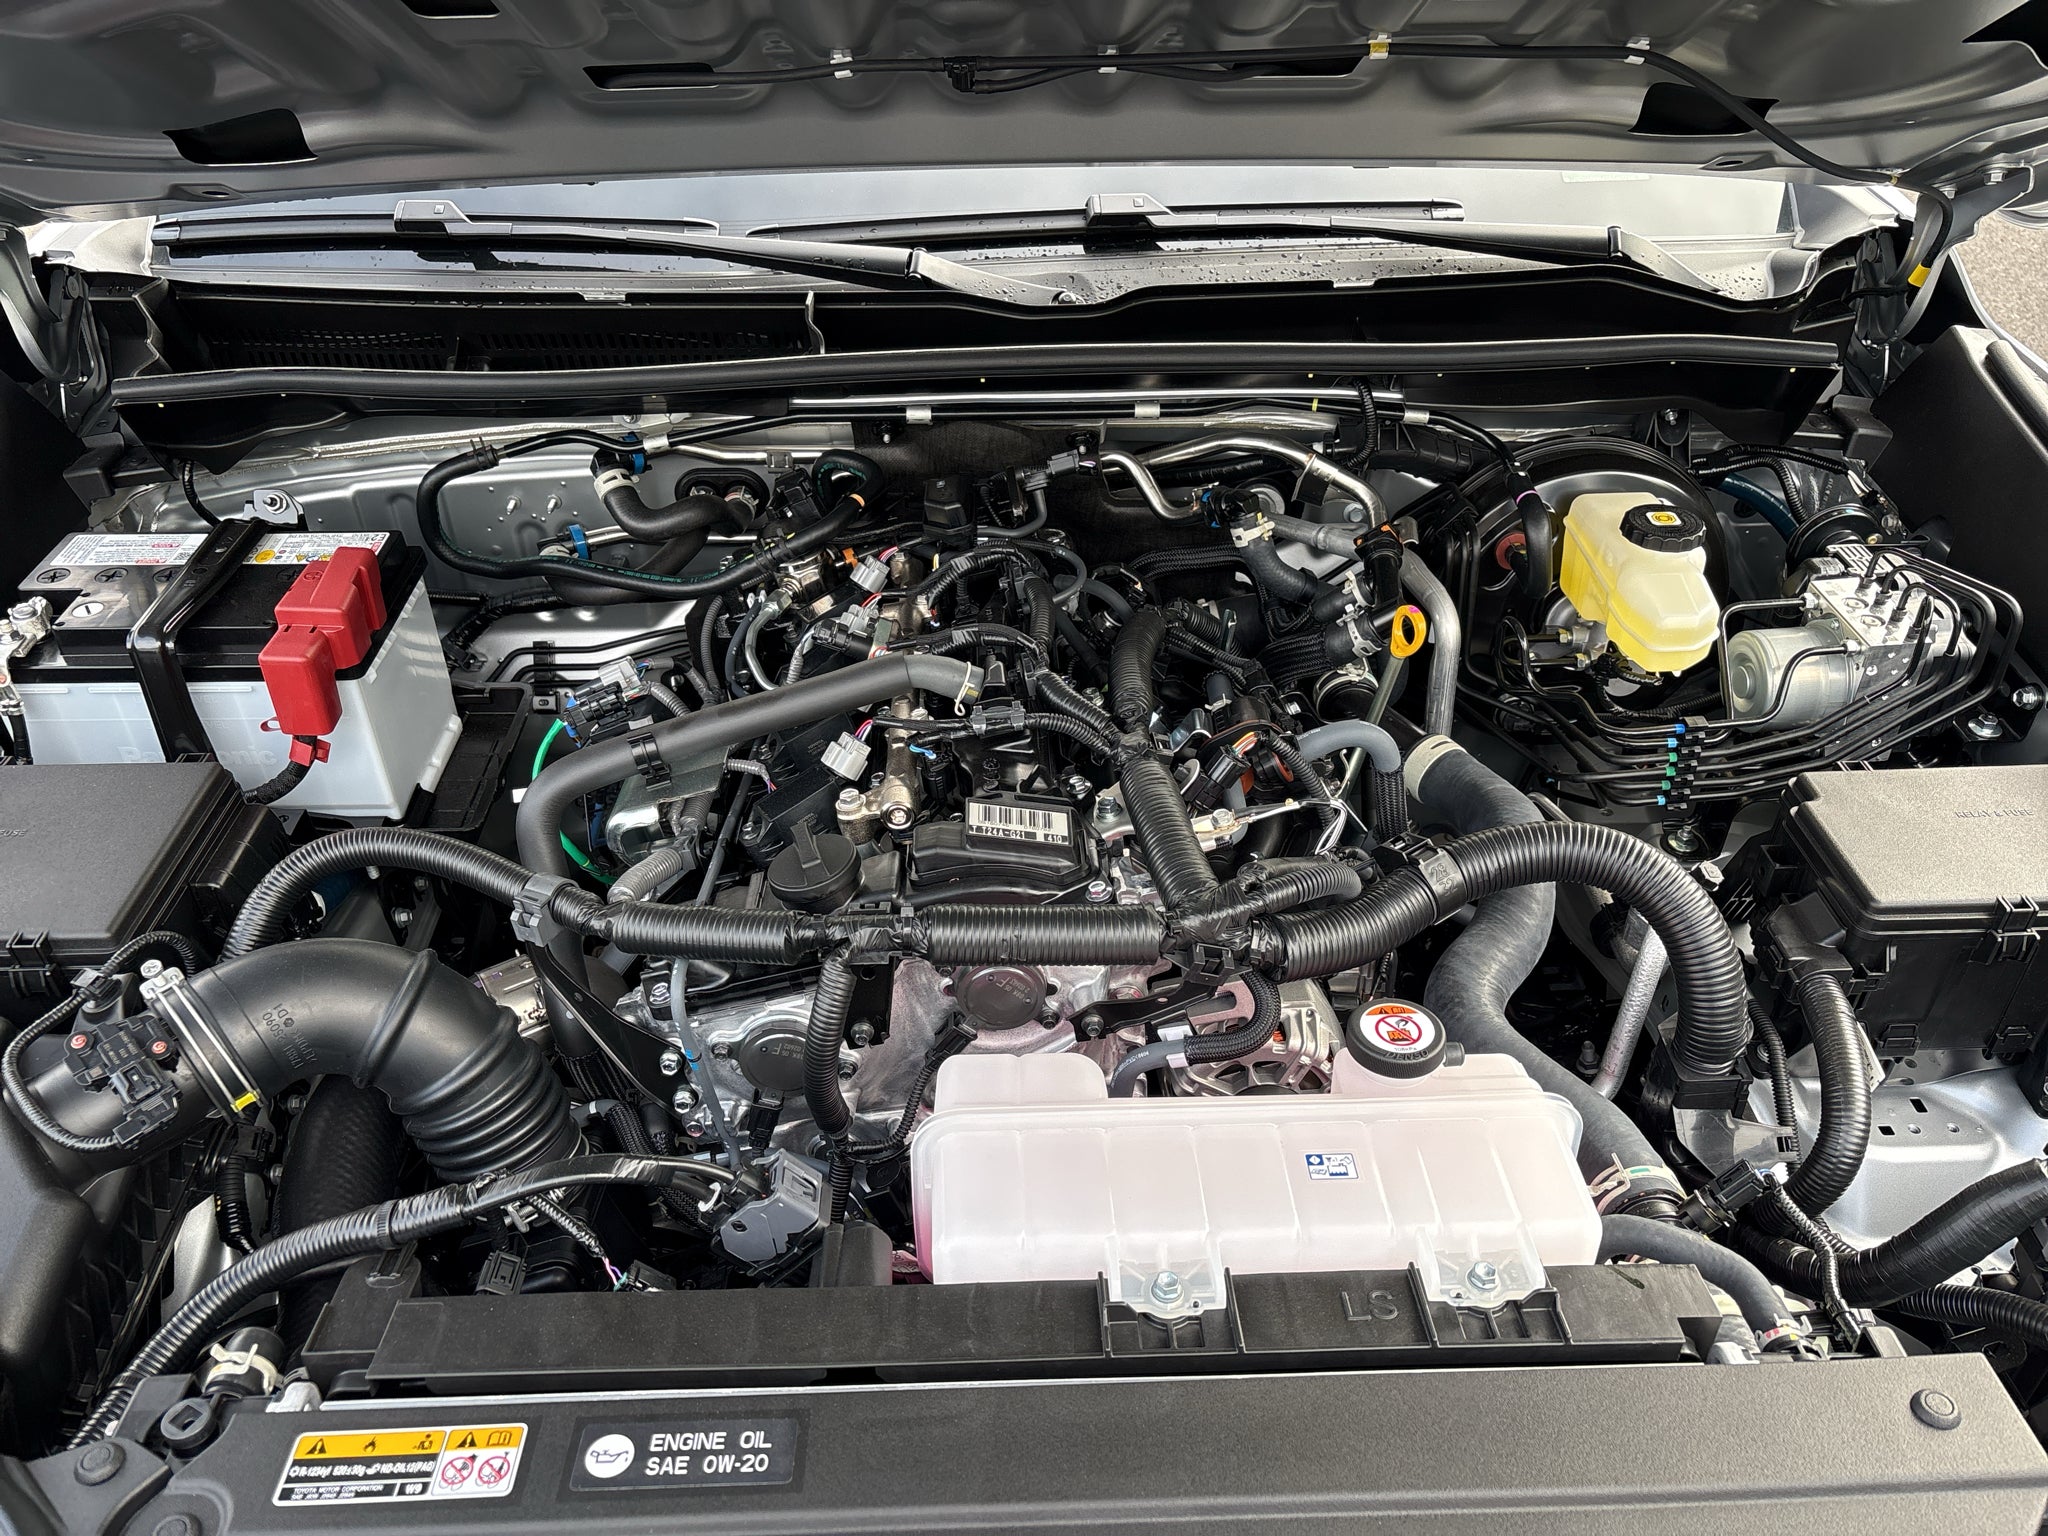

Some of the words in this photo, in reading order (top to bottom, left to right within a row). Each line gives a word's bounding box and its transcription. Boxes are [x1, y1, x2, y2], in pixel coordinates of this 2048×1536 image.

[1955, 810, 1991, 818] RELAY
[982, 826, 1025, 839] T24A-G21
[1047, 834, 1062, 843] 410
[1430, 862, 1449, 882] 28
[1438, 877, 1457, 896] 32
[262, 1012, 287, 1043] 25090
[1385, 1049, 1429, 1061] DENSO
[1340, 1290, 1398, 1321] LS
[649, 1431, 728, 1452] ENGINE
[739, 1430, 772, 1449] OIL
[645, 1455, 691, 1476] SAE
[703, 1453, 770, 1474] 0W-20
[294, 1487, 318, 1495] TOYOTA
[318, 1486, 341, 1494] MOTOR
[341, 1484, 385, 1493] CORPORATION
[405, 1483, 423, 1495] W9
